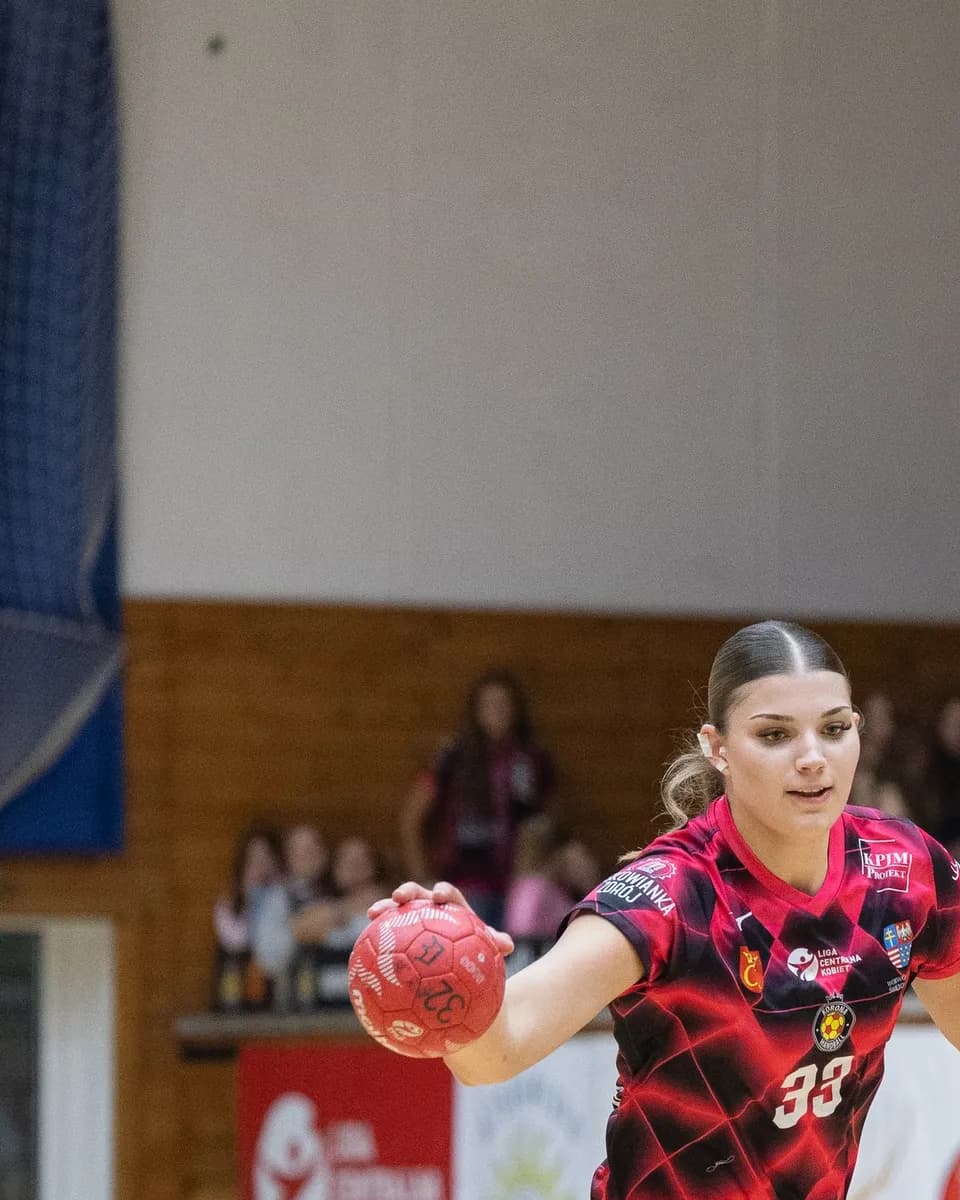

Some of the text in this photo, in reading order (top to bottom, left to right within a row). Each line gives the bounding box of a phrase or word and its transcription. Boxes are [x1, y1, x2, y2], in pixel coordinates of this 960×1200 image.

[864, 852, 908, 867] KPIM
[817, 948, 837, 958] LIGA
[821, 964, 851, 977] KOBIET
[772, 1055, 854, 1130] 33
